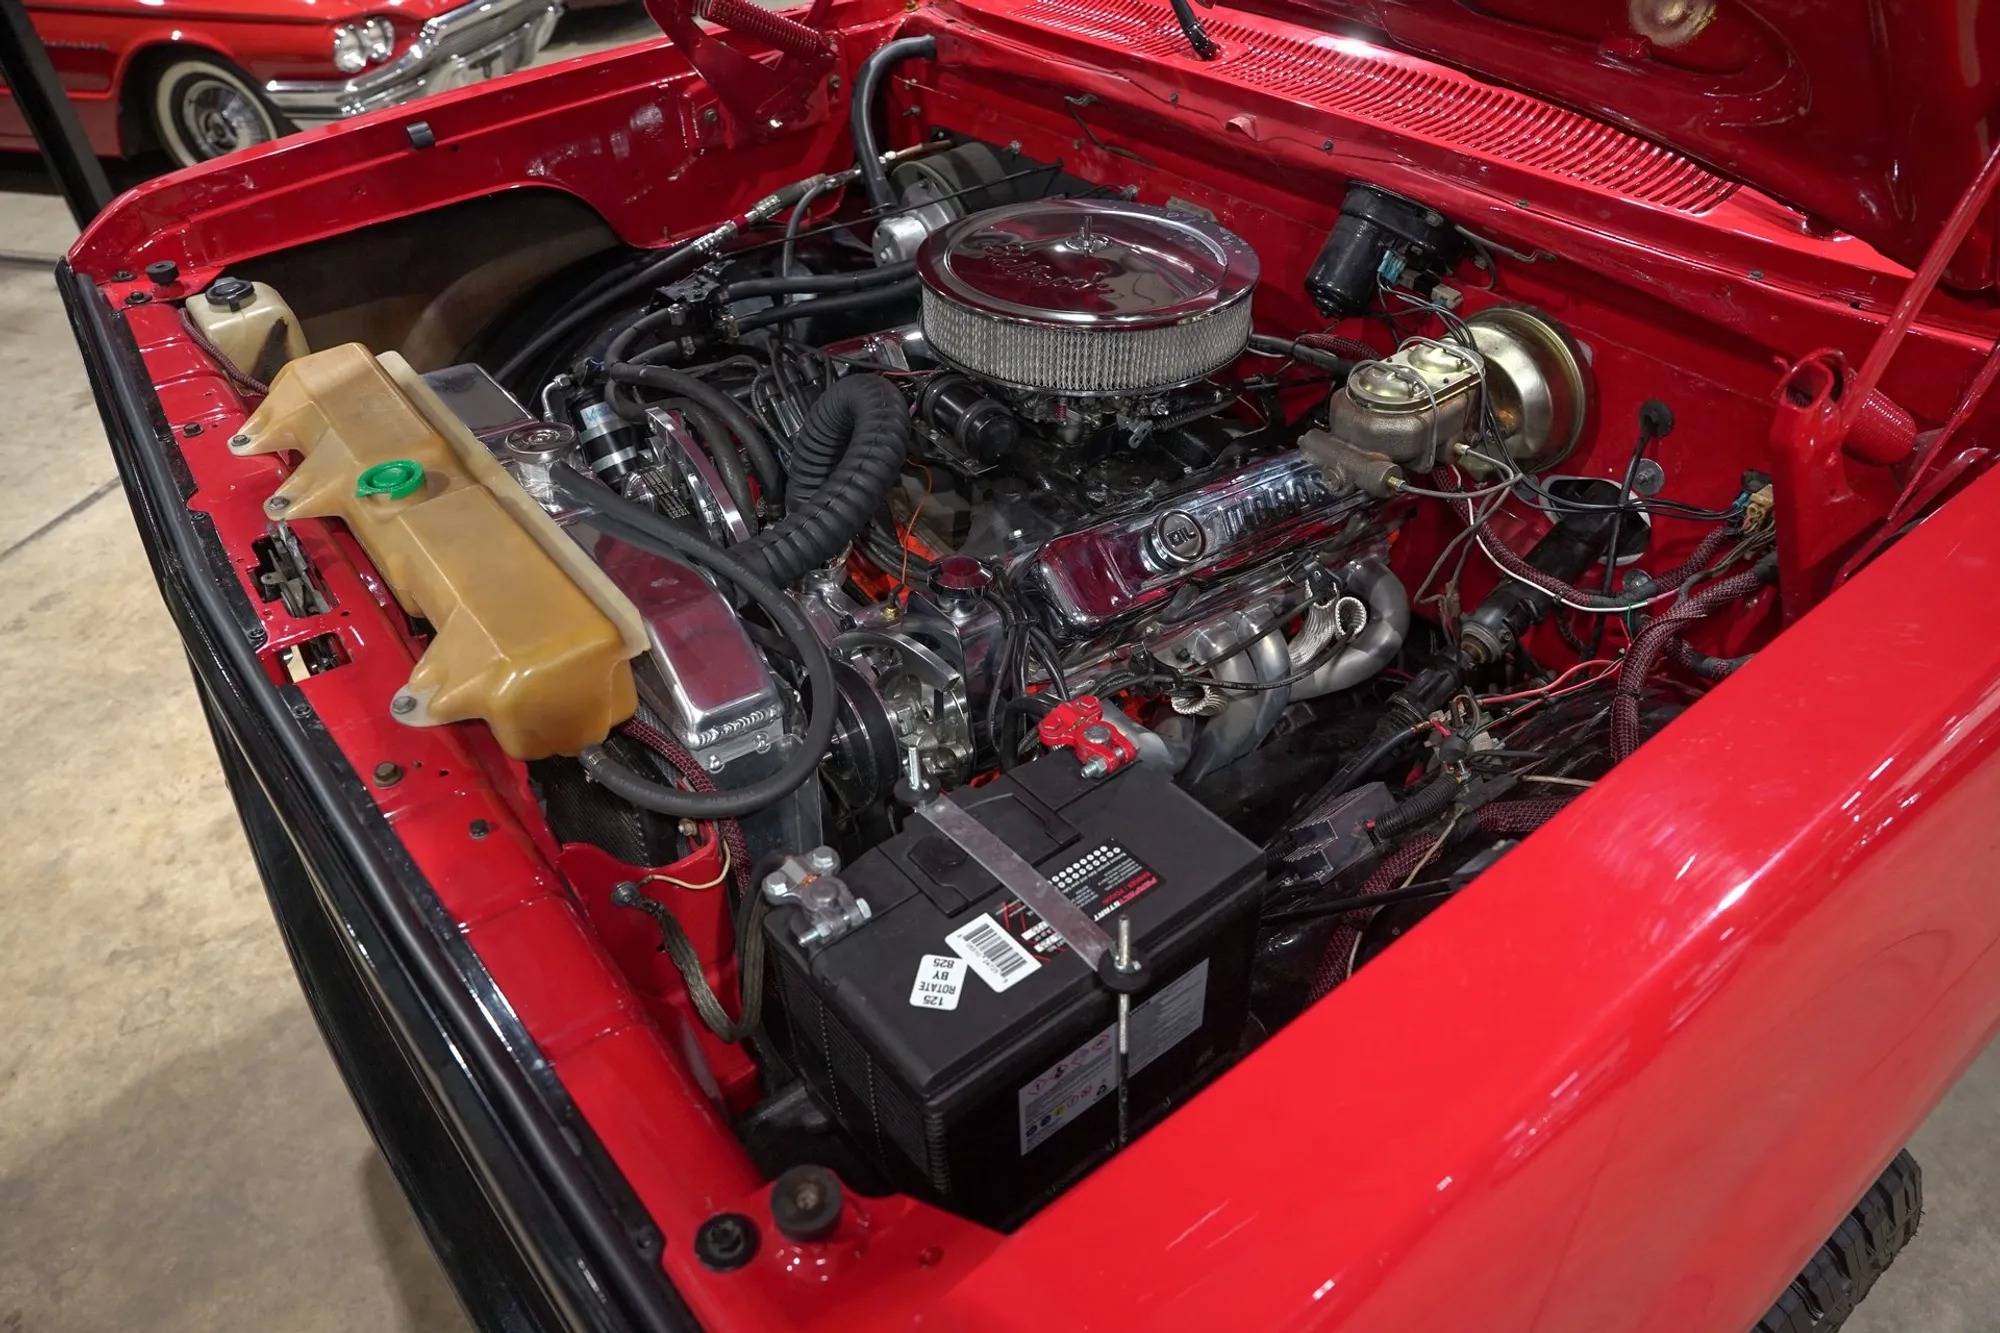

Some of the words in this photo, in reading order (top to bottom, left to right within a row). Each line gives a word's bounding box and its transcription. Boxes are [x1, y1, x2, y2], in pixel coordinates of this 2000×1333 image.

[1166, 526, 1197, 547] OIL
[933, 958, 955, 969] 825
[932, 970, 949, 981] BY
[918, 981, 956, 995] ROTATE
[923, 995, 943, 1006] 125
